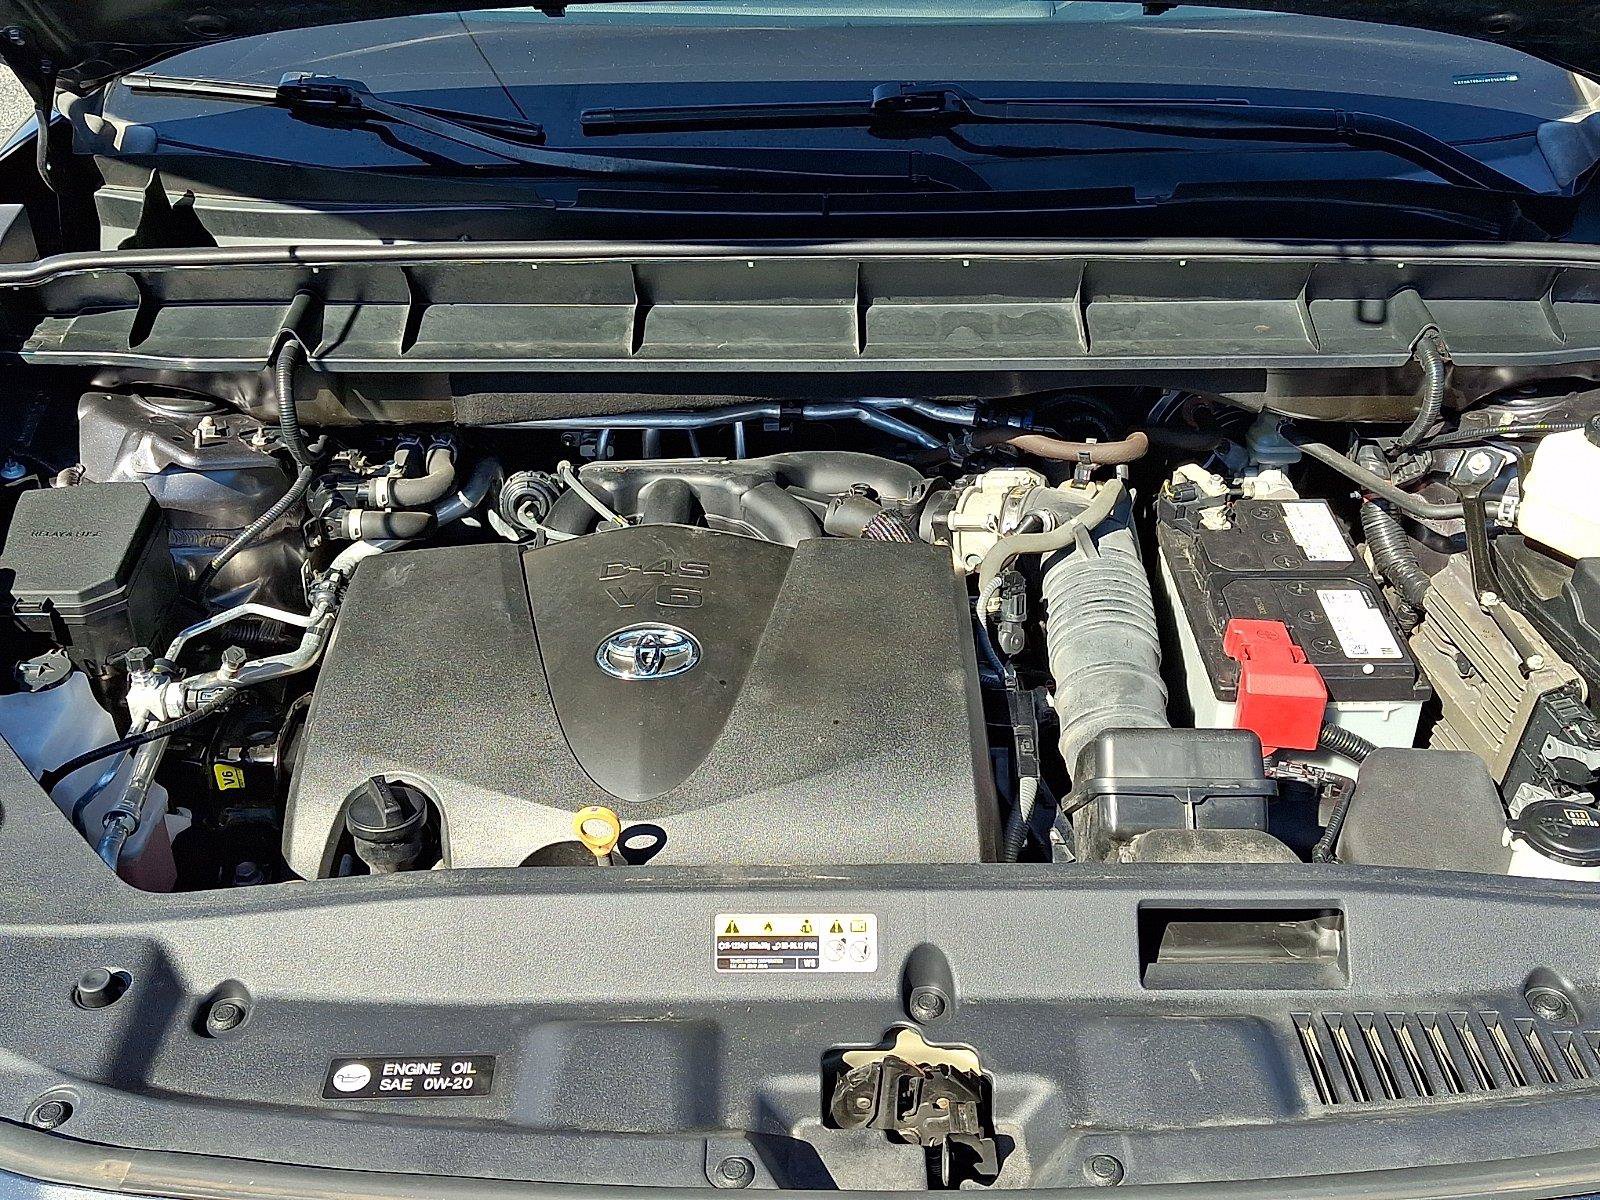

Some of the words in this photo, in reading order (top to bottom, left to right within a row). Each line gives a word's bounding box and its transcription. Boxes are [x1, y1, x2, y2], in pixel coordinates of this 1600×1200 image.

[599, 559, 711, 580] D-4S
[604, 583, 703, 609] V6
[221, 770, 236, 786] V6
[382, 1062, 442, 1076] ENGINE
[451, 1061, 477, 1075] OIL
[379, 1078, 414, 1091] SAE
[423, 1077, 474, 1091] 0W-20
